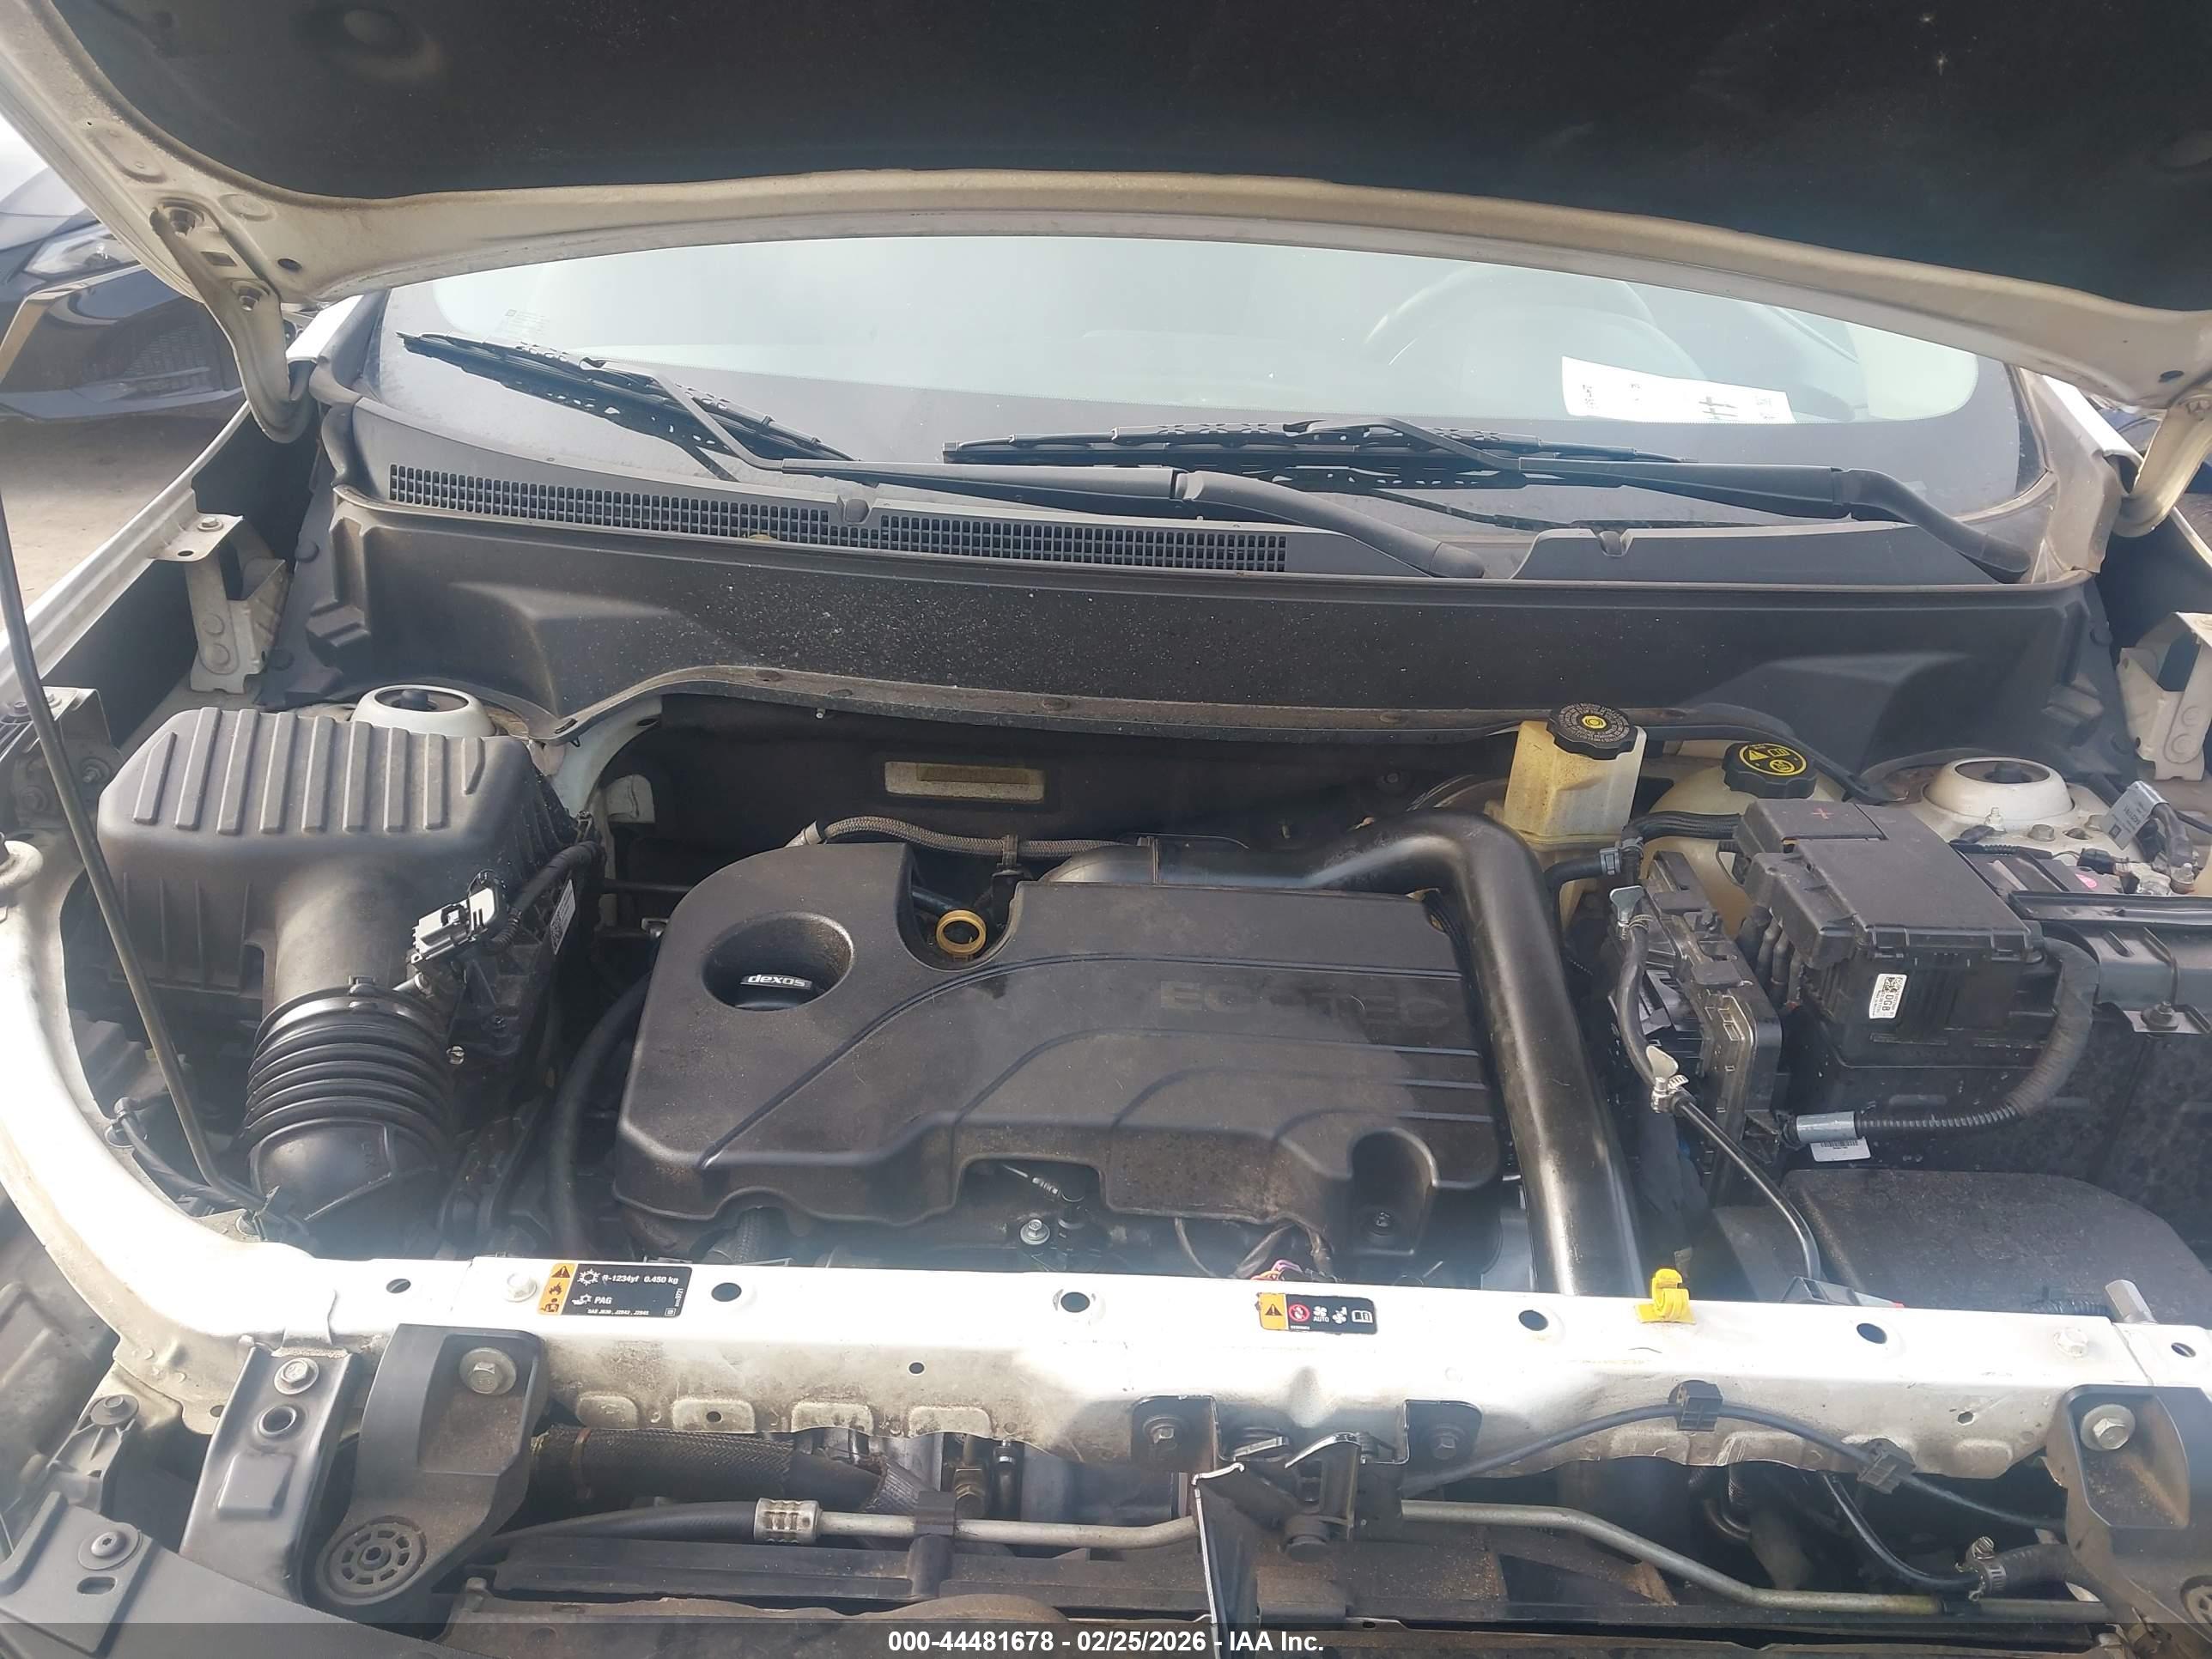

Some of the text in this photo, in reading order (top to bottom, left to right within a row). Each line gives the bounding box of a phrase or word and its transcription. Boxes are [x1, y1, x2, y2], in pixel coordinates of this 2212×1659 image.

[747, 974, 805, 987] dexos
[602, 1274, 640, 1283] R-1234yf
[594, 1296, 613, 1304] PAG
